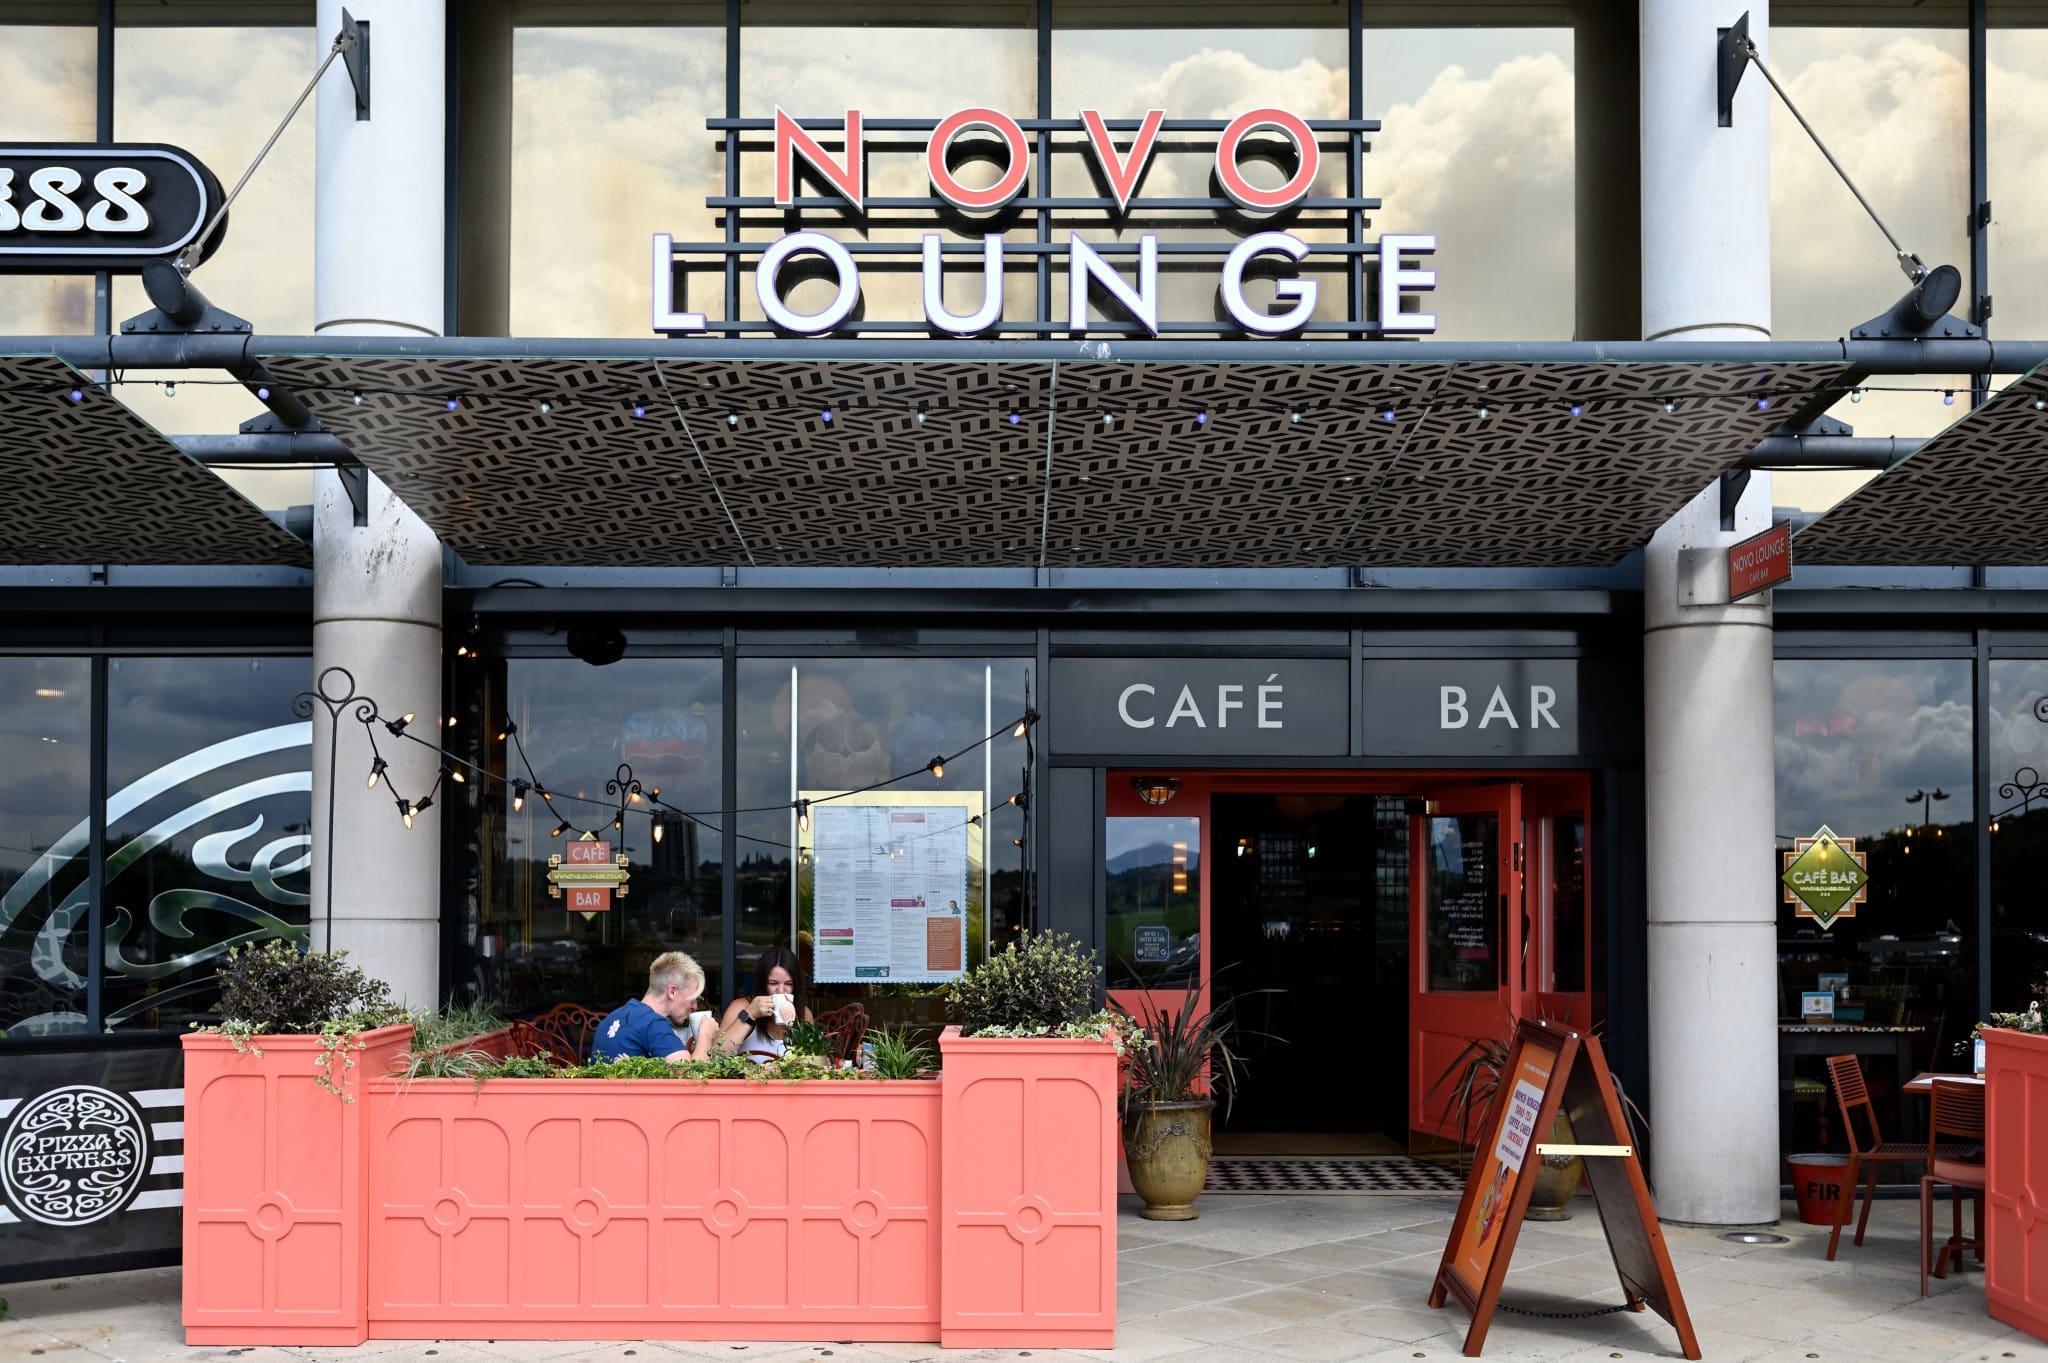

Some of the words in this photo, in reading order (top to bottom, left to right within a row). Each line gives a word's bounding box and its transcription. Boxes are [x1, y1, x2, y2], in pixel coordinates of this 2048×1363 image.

[773, 104, 1321, 213] NOVO
[651, 231, 1438, 337] LOUNGE
[1733, 551, 1754, 575] NOVO
[1755, 537, 1785, 565] LOUNGE
[1118, 673, 1283, 729] CAFÉ
[1440, 685, 1561, 729] BAR
[1792, 868, 1828, 884] CAFÉ
[1830, 871, 1859, 884] BAR
[575, 892, 601, 906] BAR
[38, 1133, 112, 1154] PIZZA
[17, 1149, 131, 1174] EXPRESS
[1807, 1181, 1850, 1200] FIR
